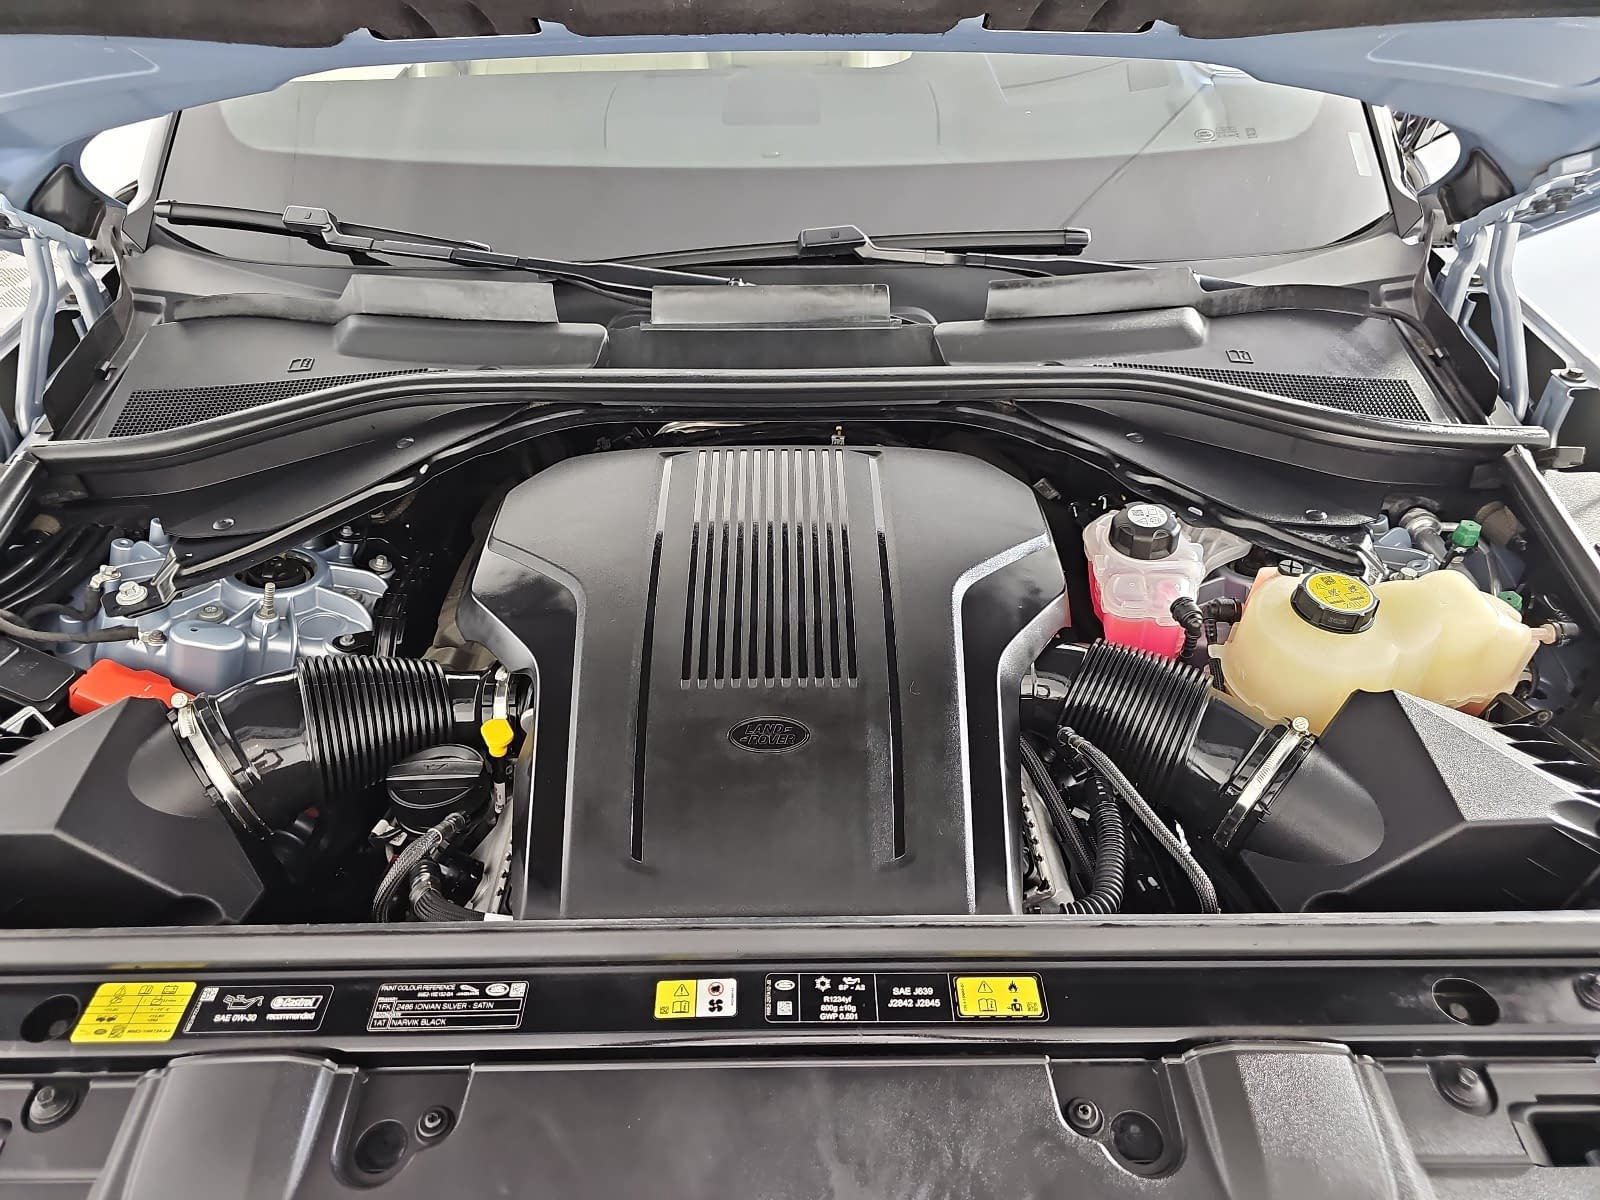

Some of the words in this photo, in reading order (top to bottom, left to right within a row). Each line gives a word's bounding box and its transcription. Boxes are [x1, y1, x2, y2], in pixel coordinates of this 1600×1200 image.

[744, 723, 784, 735] LAND
[747, 734, 796, 745] ROVER
[892, 987, 911, 995] SAE
[282, 997, 314, 1007] Castrol
[823, 996, 852, 1004] R1234yf
[887, 998, 913, 1008] J2842
[915, 998, 941, 1008] J2845
[414, 1002, 441, 1010] IONIAN
[442, 1002, 467, 1010] SILVER
[472, 1001, 495, 1009] SATIN
[213, 1014, 232, 1023] SAE
[231, 1013, 258, 1022] 0W-30
[266, 1012, 316, 1020] recommended
[819, 1012, 838, 1020] GWP
[420, 1018, 447, 1026] BLACK
